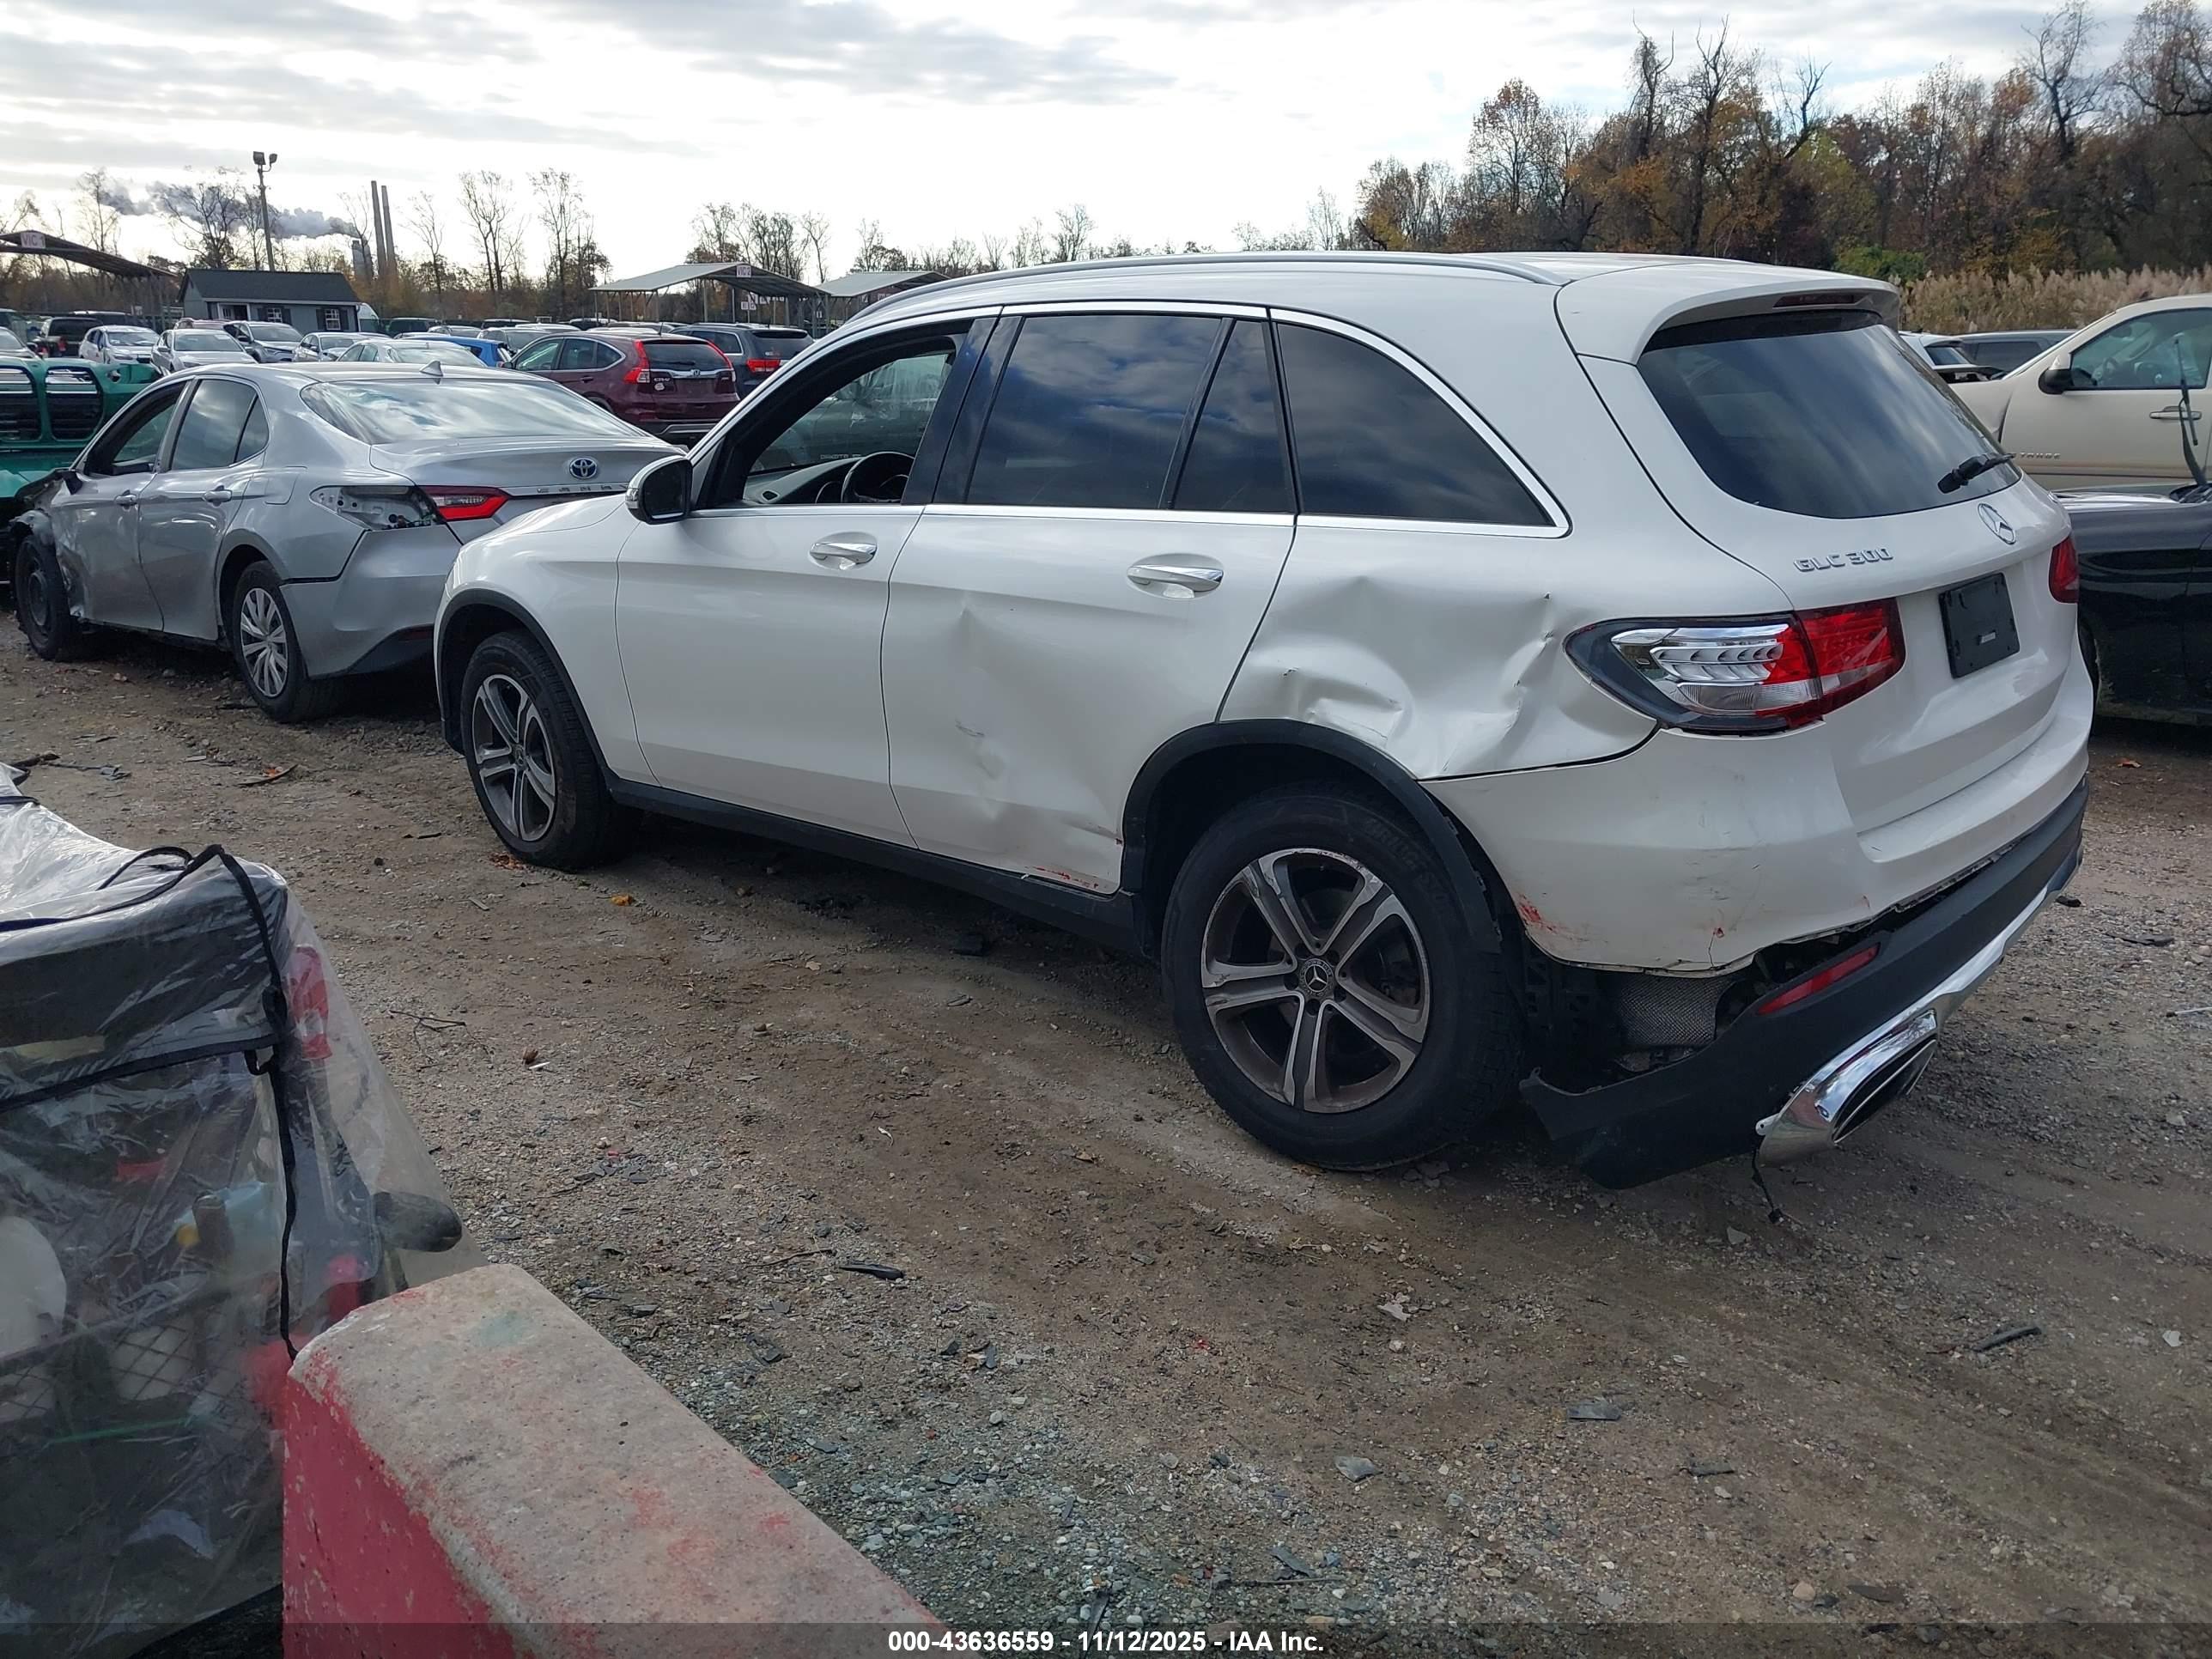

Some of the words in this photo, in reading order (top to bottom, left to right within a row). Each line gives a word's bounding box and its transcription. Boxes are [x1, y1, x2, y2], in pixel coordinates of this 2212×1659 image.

[22, 234, 38, 246] VIC
[1793, 555, 1845, 573] GLC
[1844, 548, 1894, 566] 300
